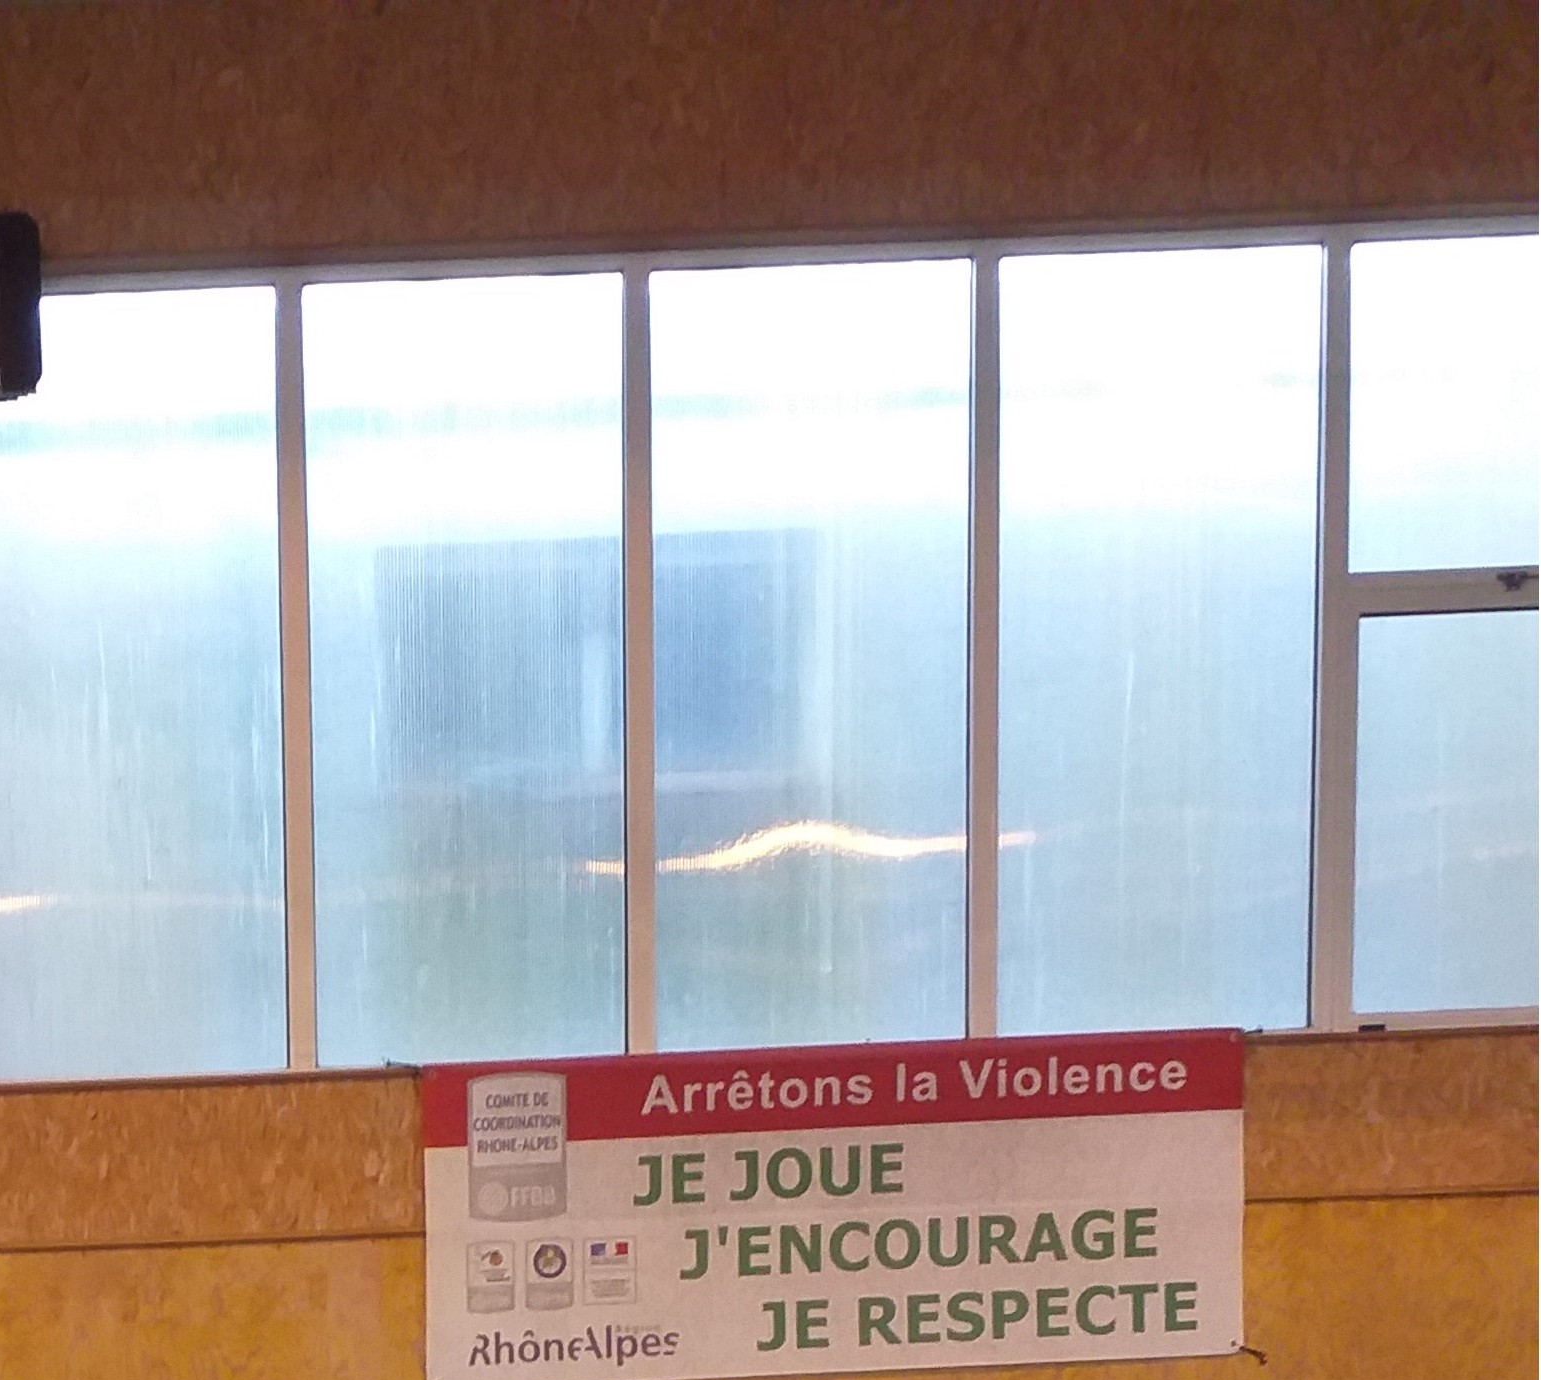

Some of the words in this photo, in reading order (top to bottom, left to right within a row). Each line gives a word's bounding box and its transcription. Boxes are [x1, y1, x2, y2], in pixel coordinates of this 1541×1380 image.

[640, 1069, 874, 1116] Arrêtons
[895, 1063, 939, 1102] la
[959, 1056, 1189, 1100] Violence
[473, 1114, 561, 1132] COORDINATION
[633, 1152, 706, 1206] JE
[729, 1143, 904, 1202] JOUE
[679, 1208, 1158, 1280] J'ENCOURAGE
[756, 1299, 830, 1351] JE
[857, 1282, 1198, 1348] RESPECTE
